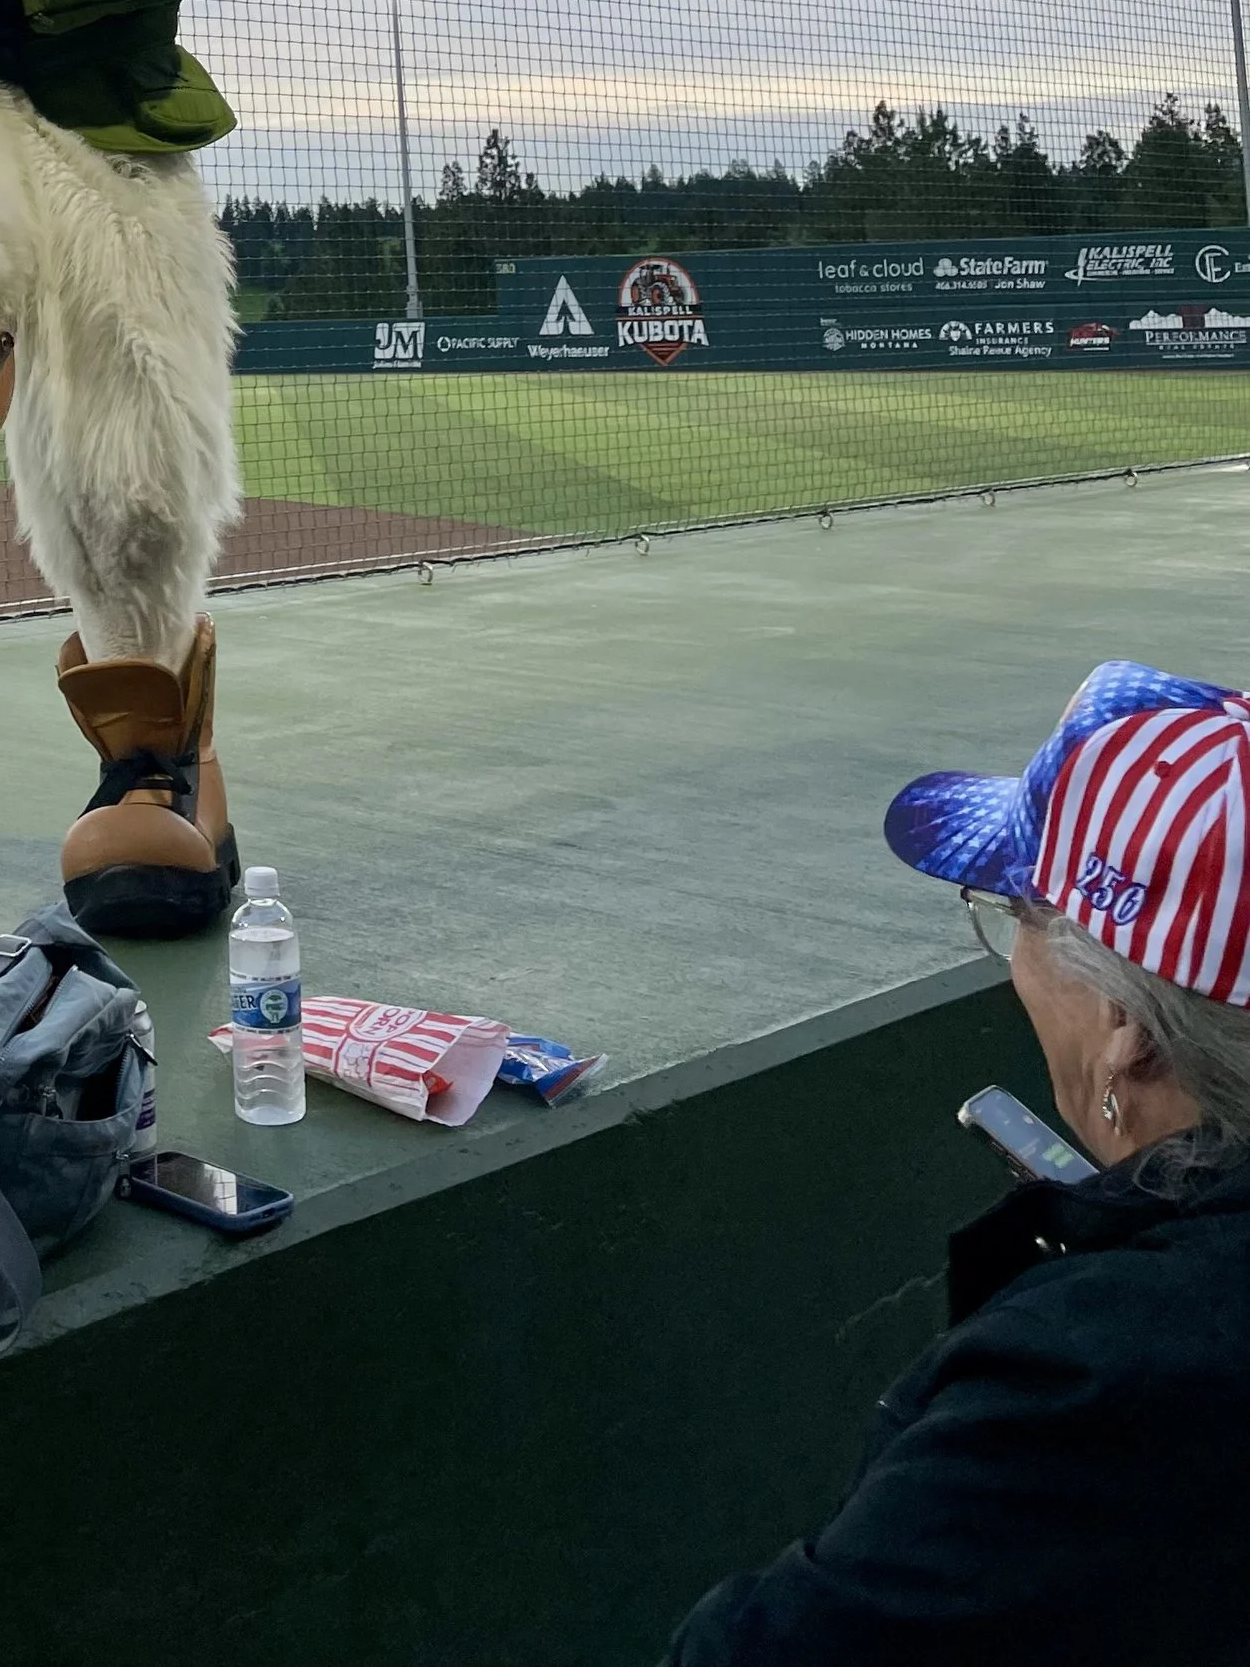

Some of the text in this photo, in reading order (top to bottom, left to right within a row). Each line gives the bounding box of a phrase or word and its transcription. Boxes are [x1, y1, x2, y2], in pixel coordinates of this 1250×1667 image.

[1088, 244, 1174, 260] KALISPELL
[818, 257, 924, 279] leaf & cloud
[1015, 277, 1046, 289] Shaw
[627, 304, 694, 316] KALISPELL
[617, 319, 710, 348] KUBOTA
[845, 328, 932, 341] HIDDEN HOMES
[974, 321, 1055, 335] FARMERS
[452, 337, 486, 349] PACIFIC
[1015, 345, 1052, 358] Agency
[1075, 850, 1148, 926] 250
